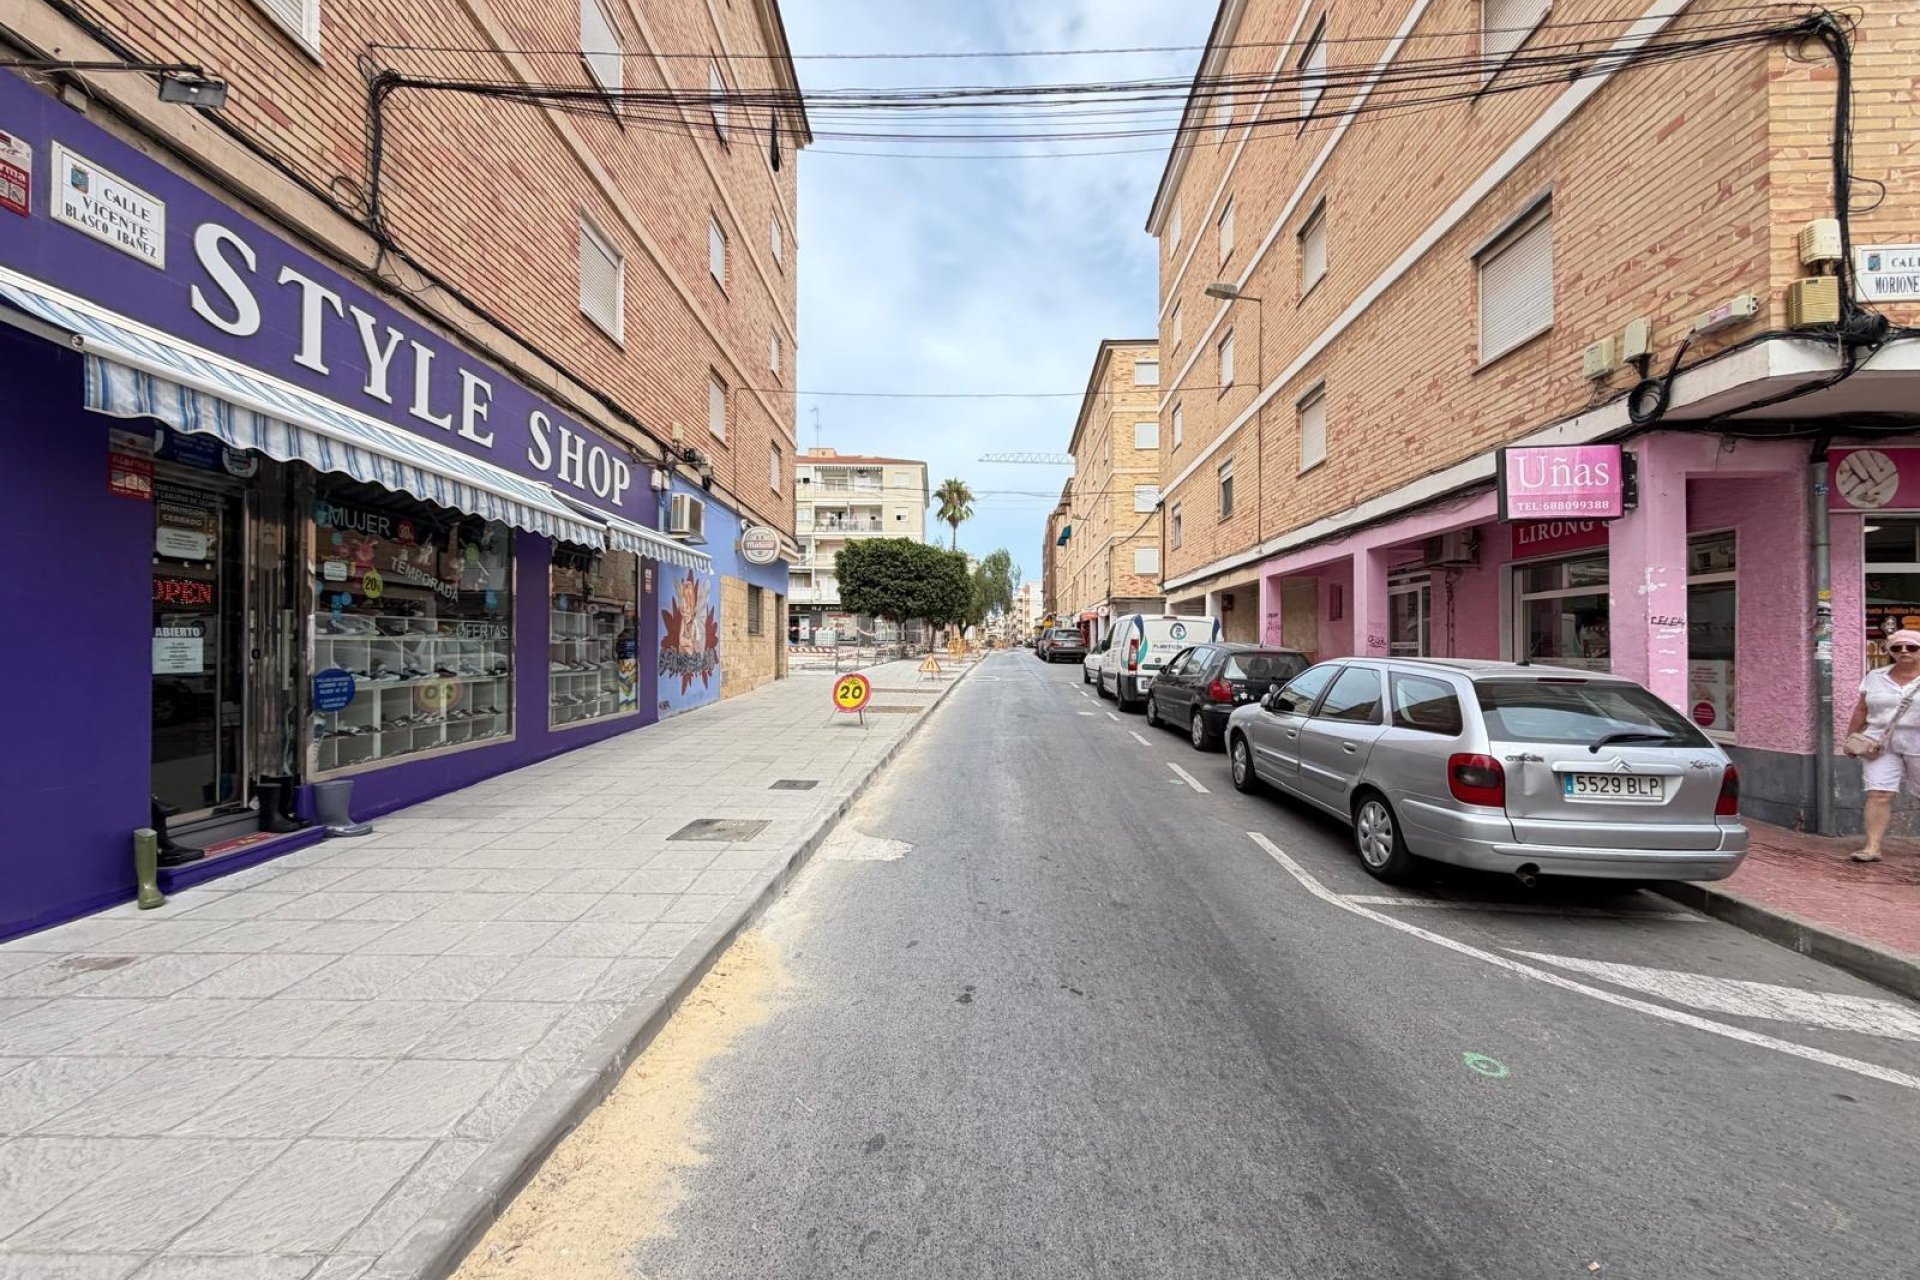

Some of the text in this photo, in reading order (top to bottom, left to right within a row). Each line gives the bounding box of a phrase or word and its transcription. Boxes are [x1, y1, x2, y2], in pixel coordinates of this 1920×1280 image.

[65, 203, 108, 234] BLASCO
[83, 196, 149, 241] VICENTE
[104, 188, 151, 222] CALLE
[1891, 256, 1920, 268] CAL
[191, 223, 629, 506] STYLE SHOP
[1514, 455, 1610, 488] Uñas
[329, 505, 390, 536] MUJER
[391, 556, 458, 602] TEMPORADA
[155, 627, 200, 637] ABIERTO
[456, 623, 508, 640] OFERTAS
[840, 685, 863, 699] 20
[1576, 775, 1660, 795] 5529 BLP
